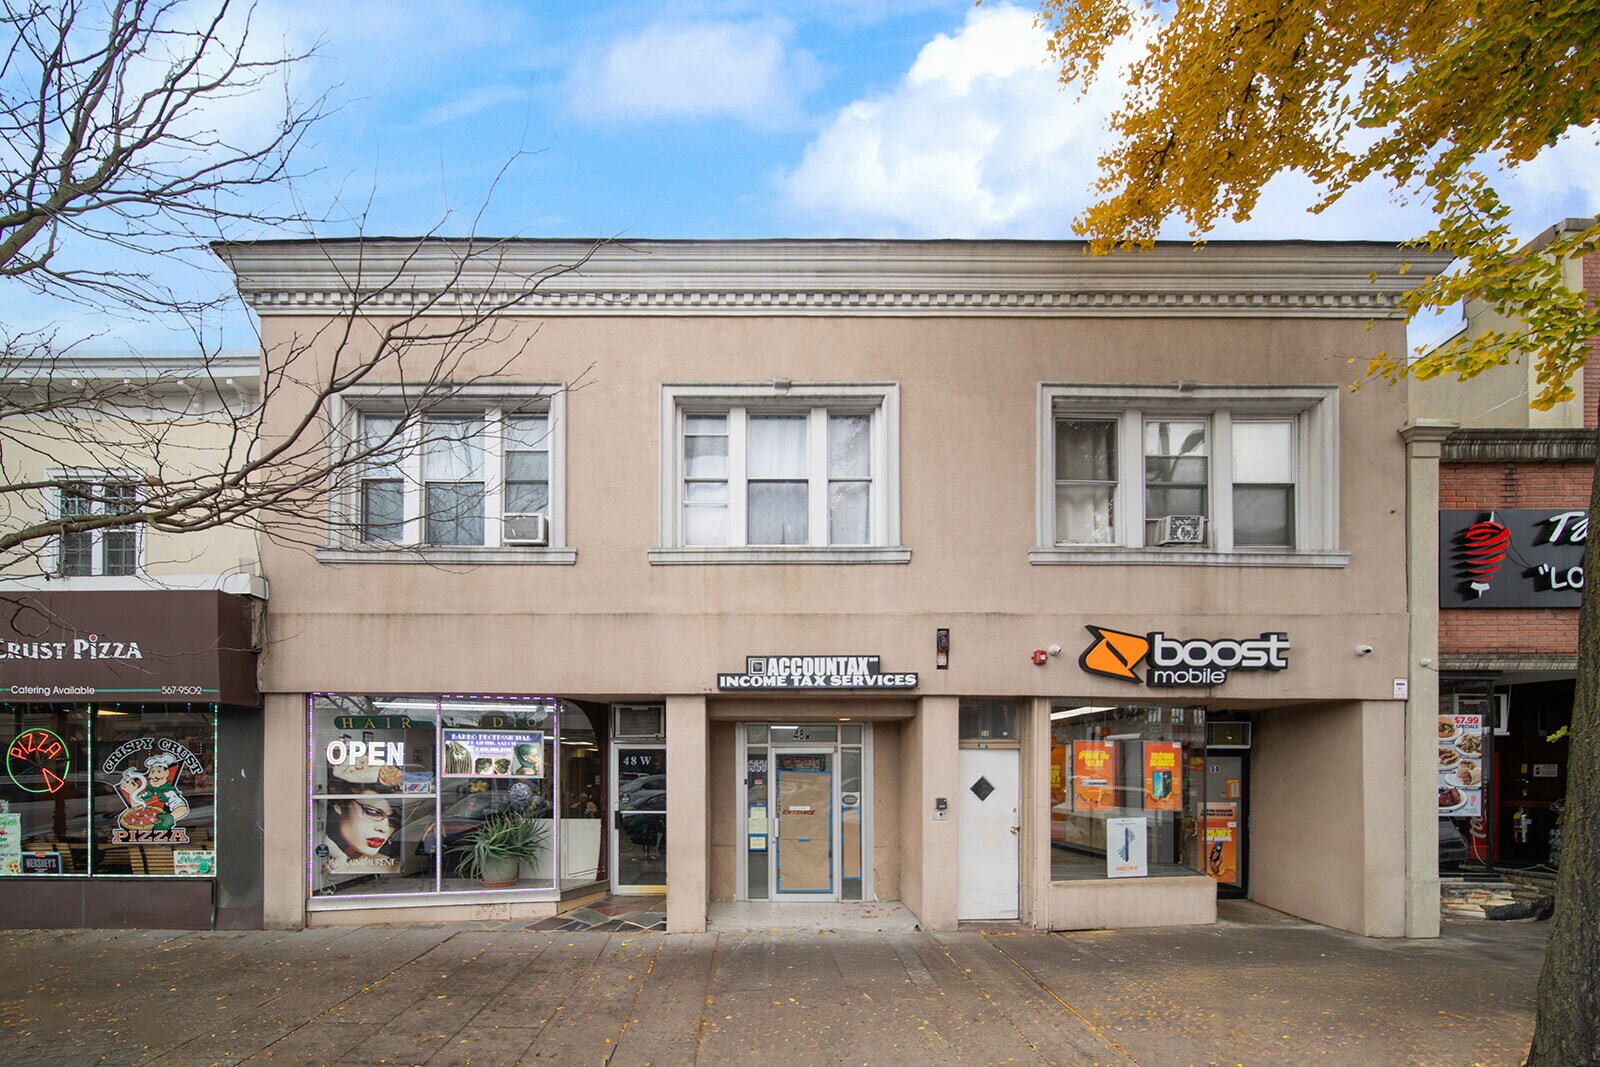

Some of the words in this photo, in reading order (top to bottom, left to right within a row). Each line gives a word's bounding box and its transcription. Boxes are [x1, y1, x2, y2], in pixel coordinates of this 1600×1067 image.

[1549, 511, 1589, 542] Ta
[0, 638, 66, 660] RUST
[1154, 633, 1290, 667] boost
[767, 657, 869, 676] ACCOUNTAX
[720, 676, 787, 687] INCOME
[795, 675, 826, 687] TAX
[830, 674, 917, 686] SERVICES
[1154, 668, 1226, 683] mobile
[10, 685, 51, 697] Catering
[52, 686, 96, 696] Available
[161, 685, 202, 695] 567-9502
[342, 717, 411, 729] HAIR
[1454, 716, 1479, 725] $7.99
[10, 732, 62, 760] PIZZA
[326, 740, 404, 766] OPEN
[104, 739, 153, 772] CRISPY
[160, 739, 203, 774] CRUST
[623, 756, 637, 765] 48
[115, 829, 187, 842] PIZZA
